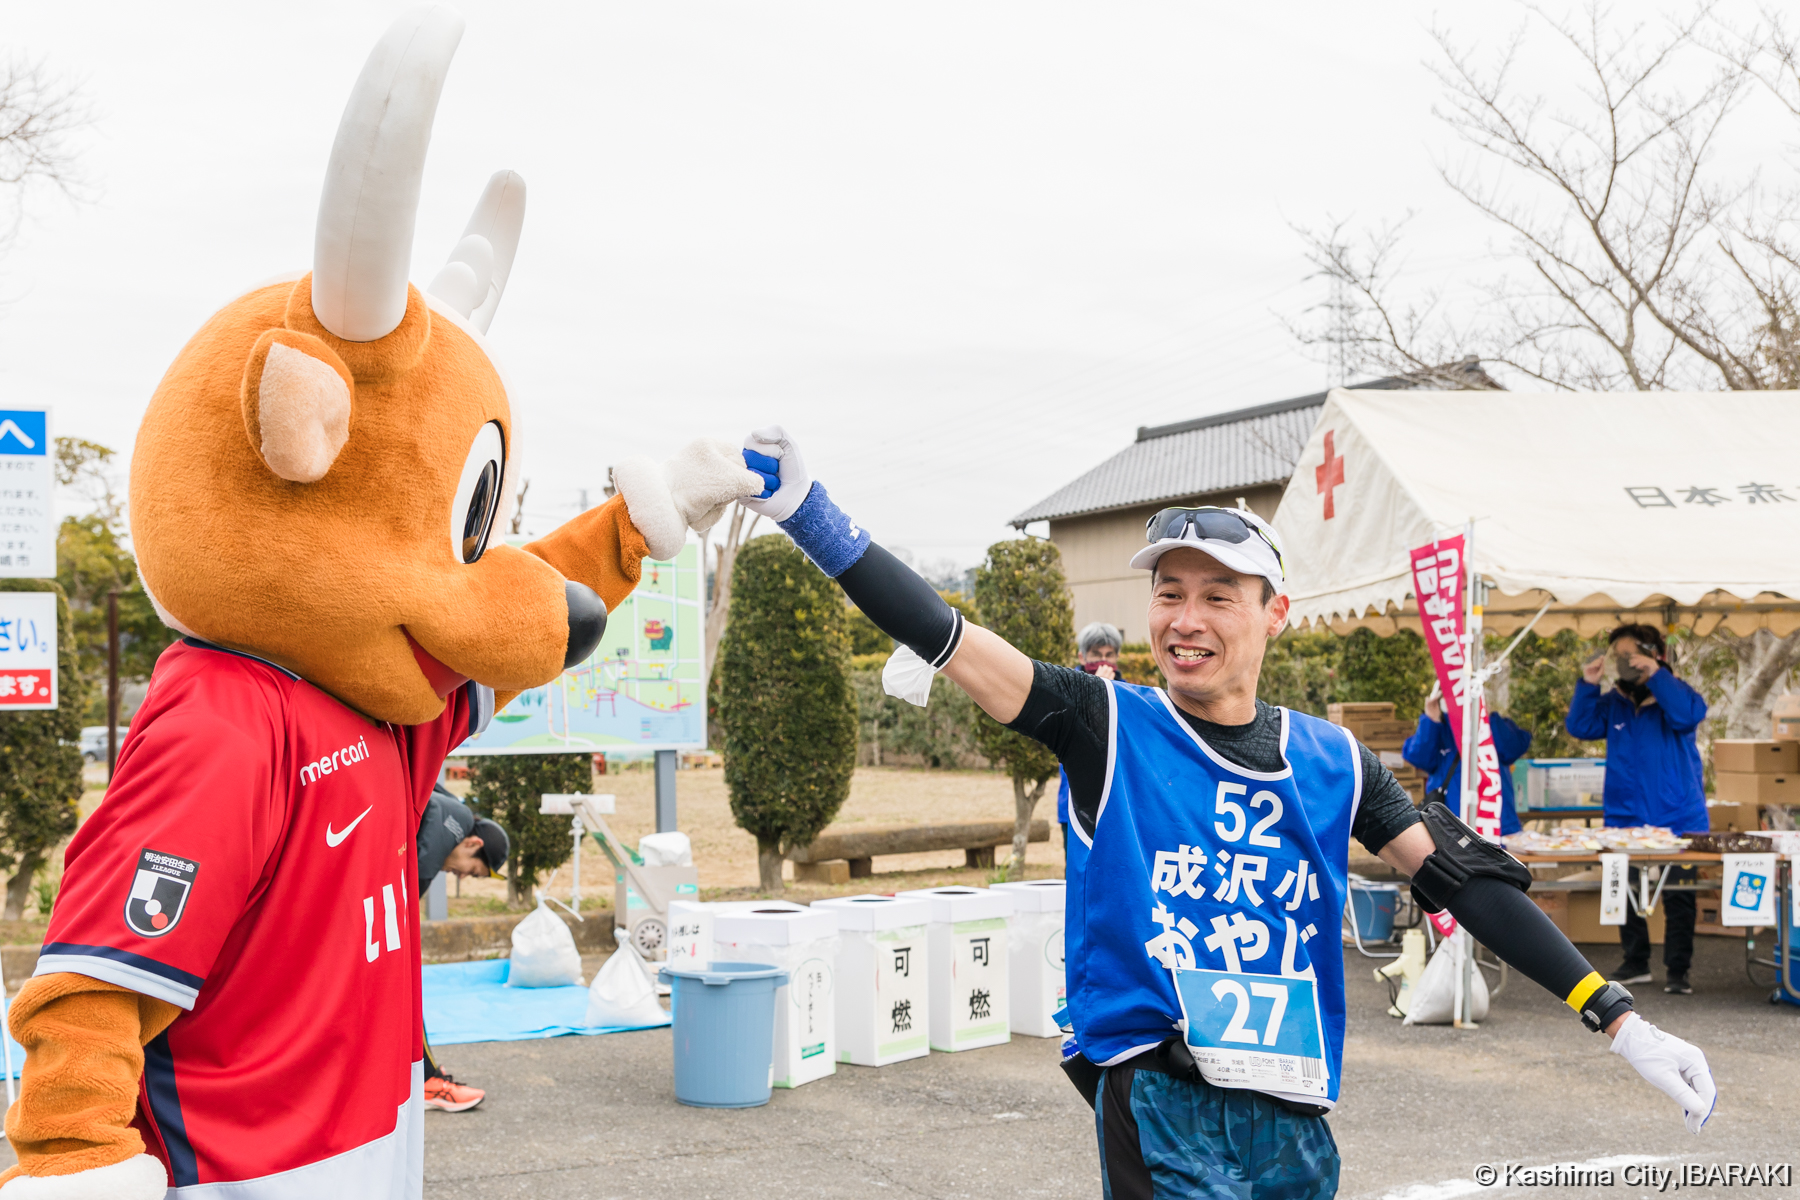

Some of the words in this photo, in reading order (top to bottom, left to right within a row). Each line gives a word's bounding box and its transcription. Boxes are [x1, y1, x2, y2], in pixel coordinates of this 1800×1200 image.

[0, 418, 36, 450] へ
[1623, 482, 1799, 509] 日本赤
[0, 675, 49, 697] ます。
[300, 735, 370, 786] mercari
[1214, 781, 1284, 849] 52
[144, 851, 195, 873] 明治安田生命
[1151, 844, 1321, 911] 成沢小
[1145, 901, 1319, 976] おやじ
[891, 946, 912, 1034] 可燃
[969, 937, 991, 1021] 可燃
[1211, 979, 1289, 1046] 27
